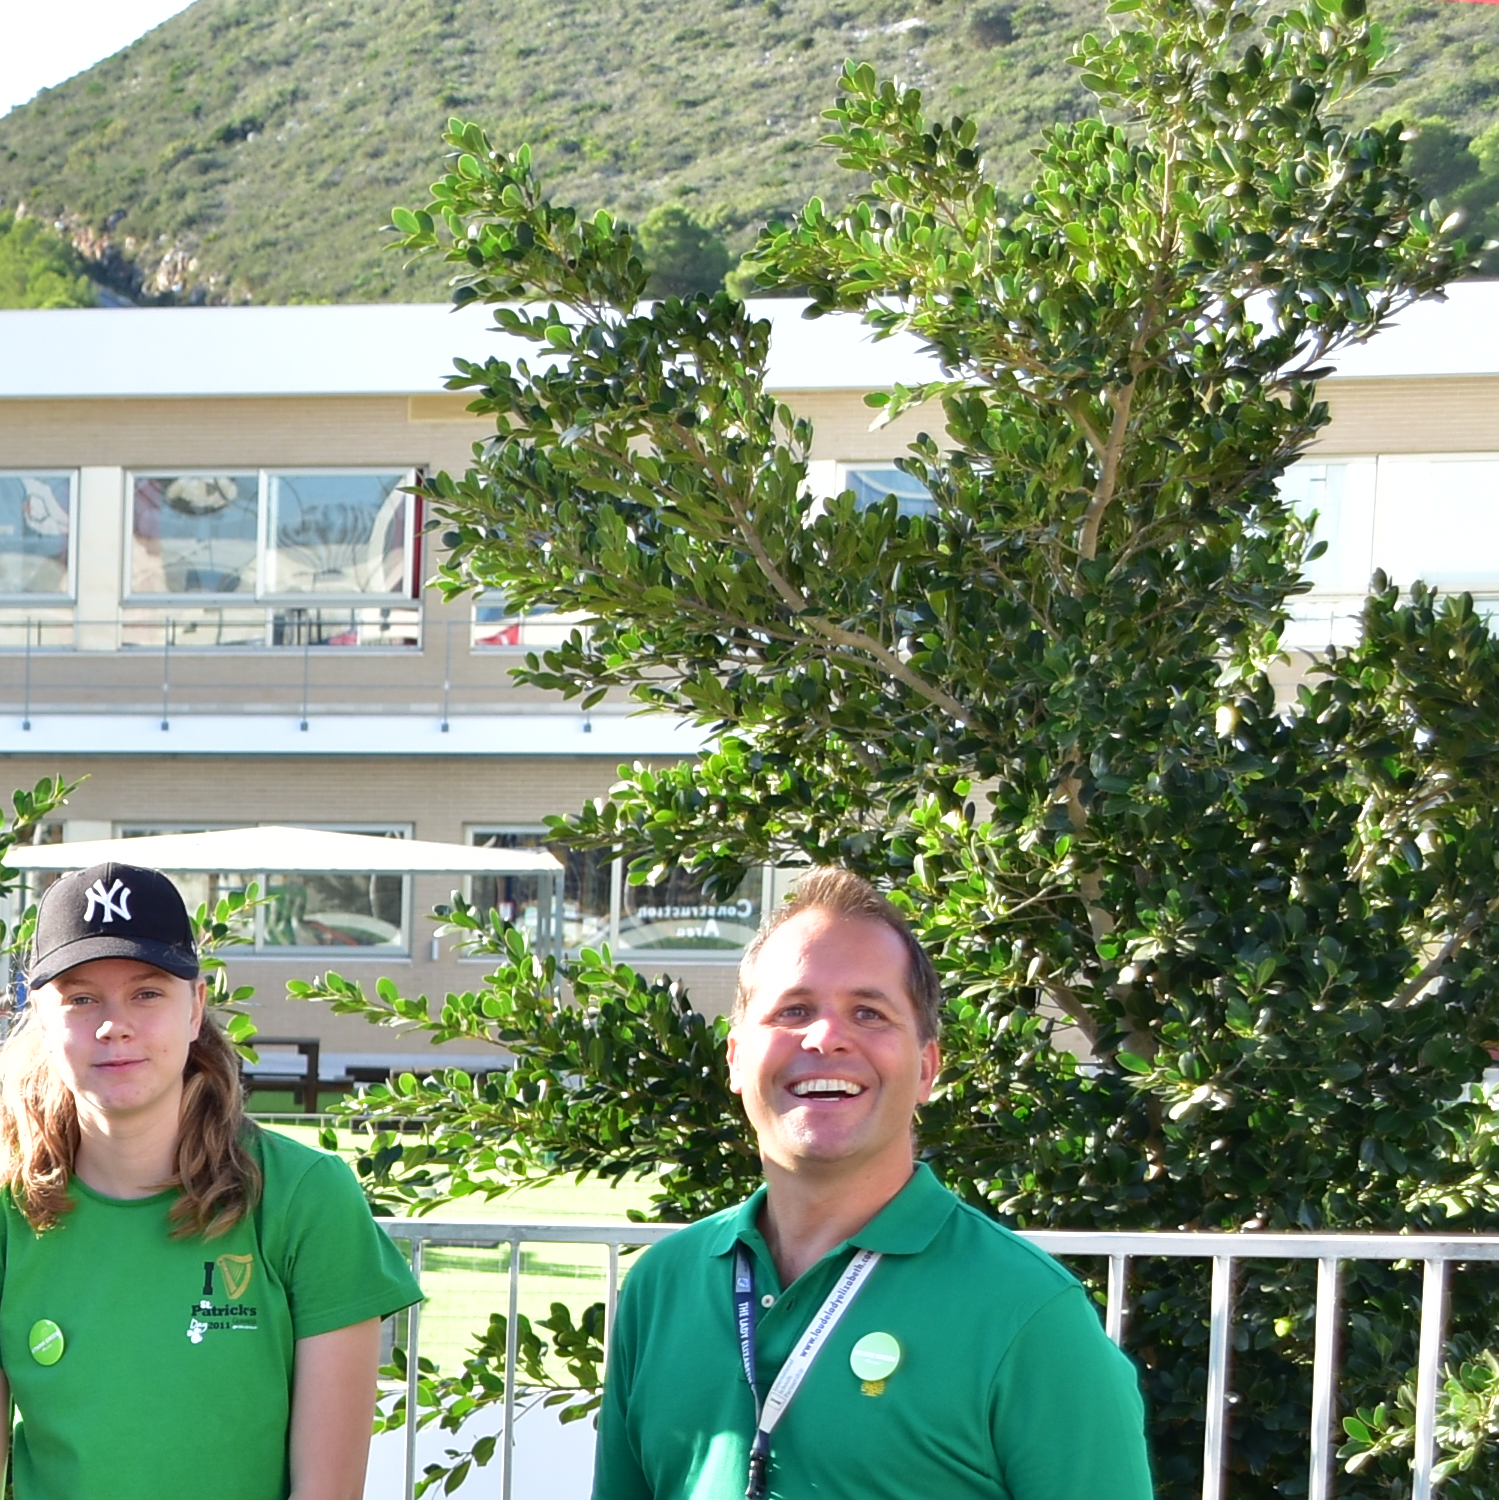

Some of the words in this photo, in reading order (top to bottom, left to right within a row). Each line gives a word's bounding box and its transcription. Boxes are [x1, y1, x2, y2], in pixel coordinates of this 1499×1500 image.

[83, 878, 132, 923] NY
[738, 1301, 749, 1317] THE
[208, 1321, 230, 1329] 2011
[739, 1317, 749, 1339] LADY
